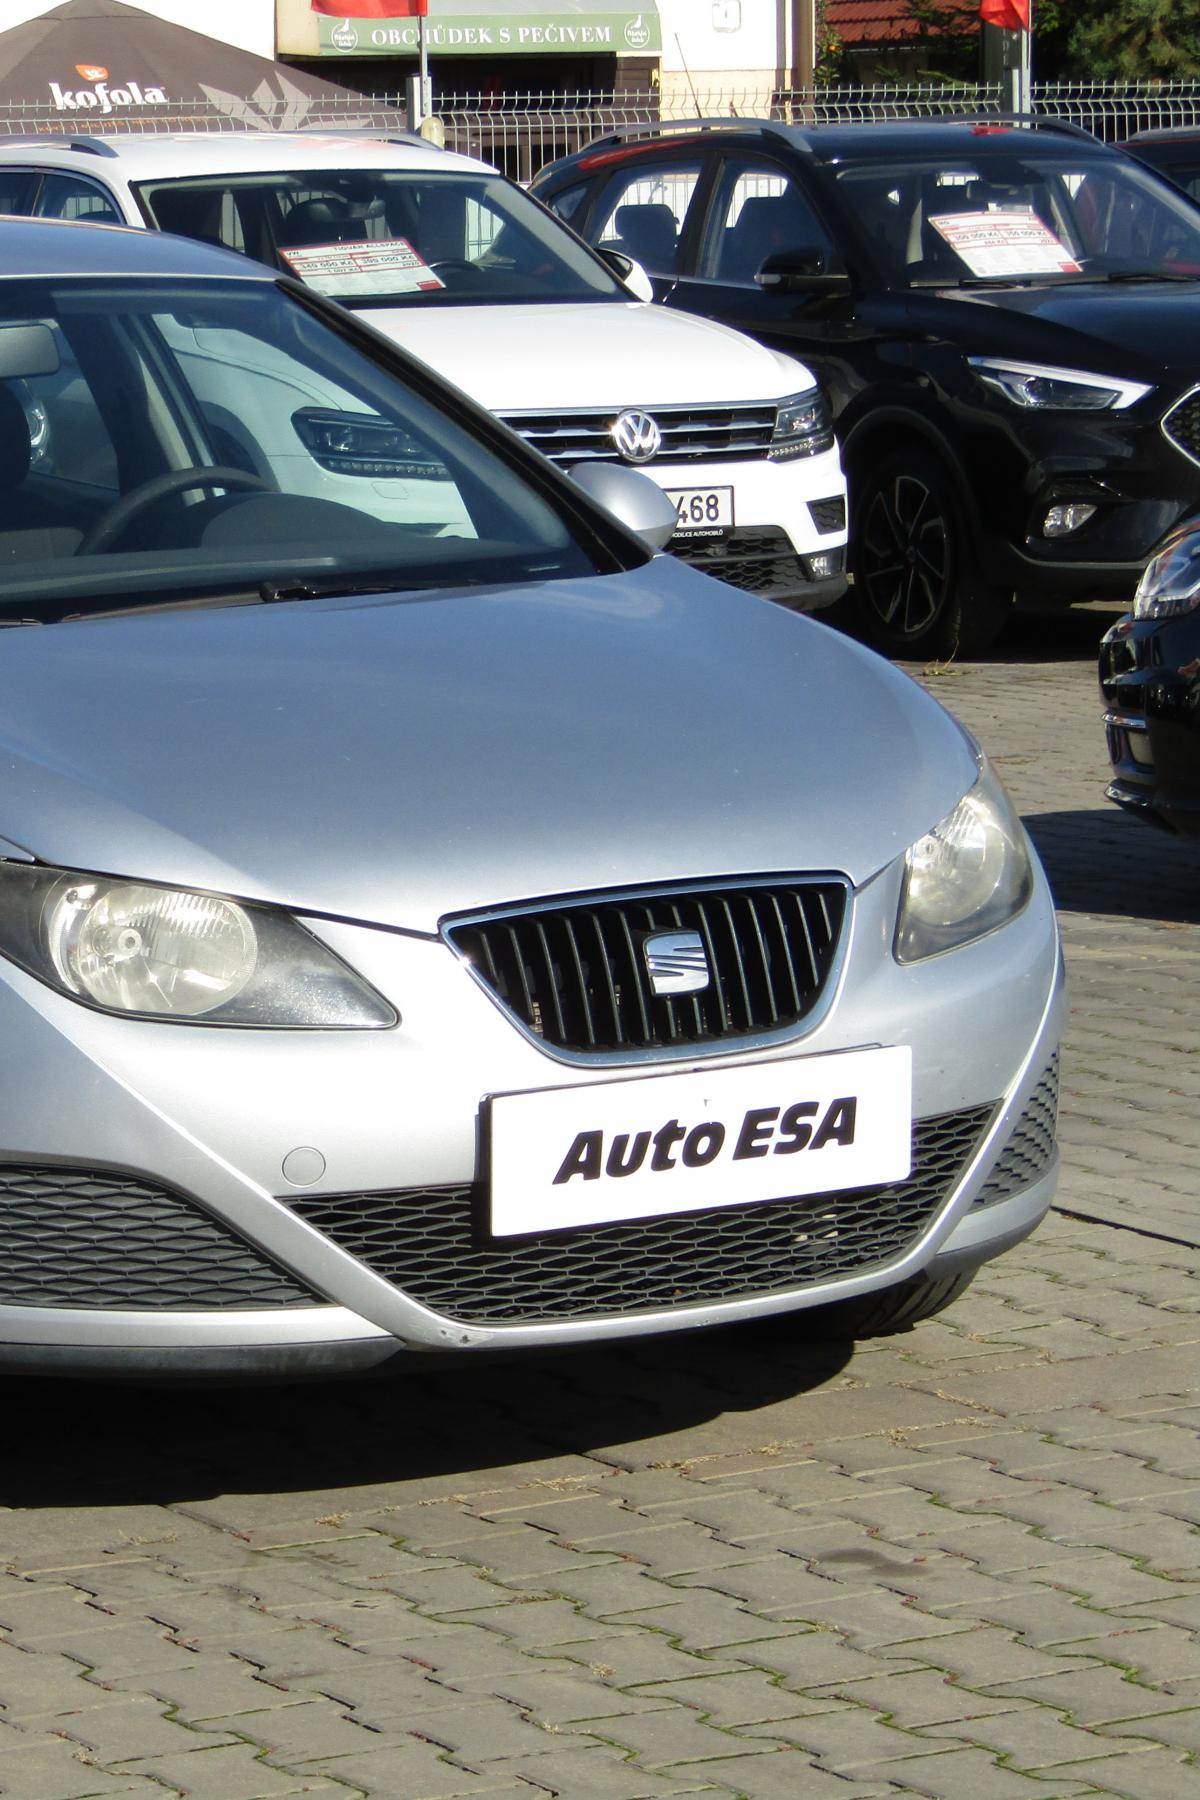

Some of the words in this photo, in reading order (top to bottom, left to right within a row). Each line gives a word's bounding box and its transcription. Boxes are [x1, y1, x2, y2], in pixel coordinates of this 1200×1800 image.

[499, 26, 511, 44] S
[518, 23, 612, 44] PEČIVEM
[48, 82, 170, 114] kofola
[551, 1119, 726, 1185] Auto
[732, 1096, 858, 1161] ESA
